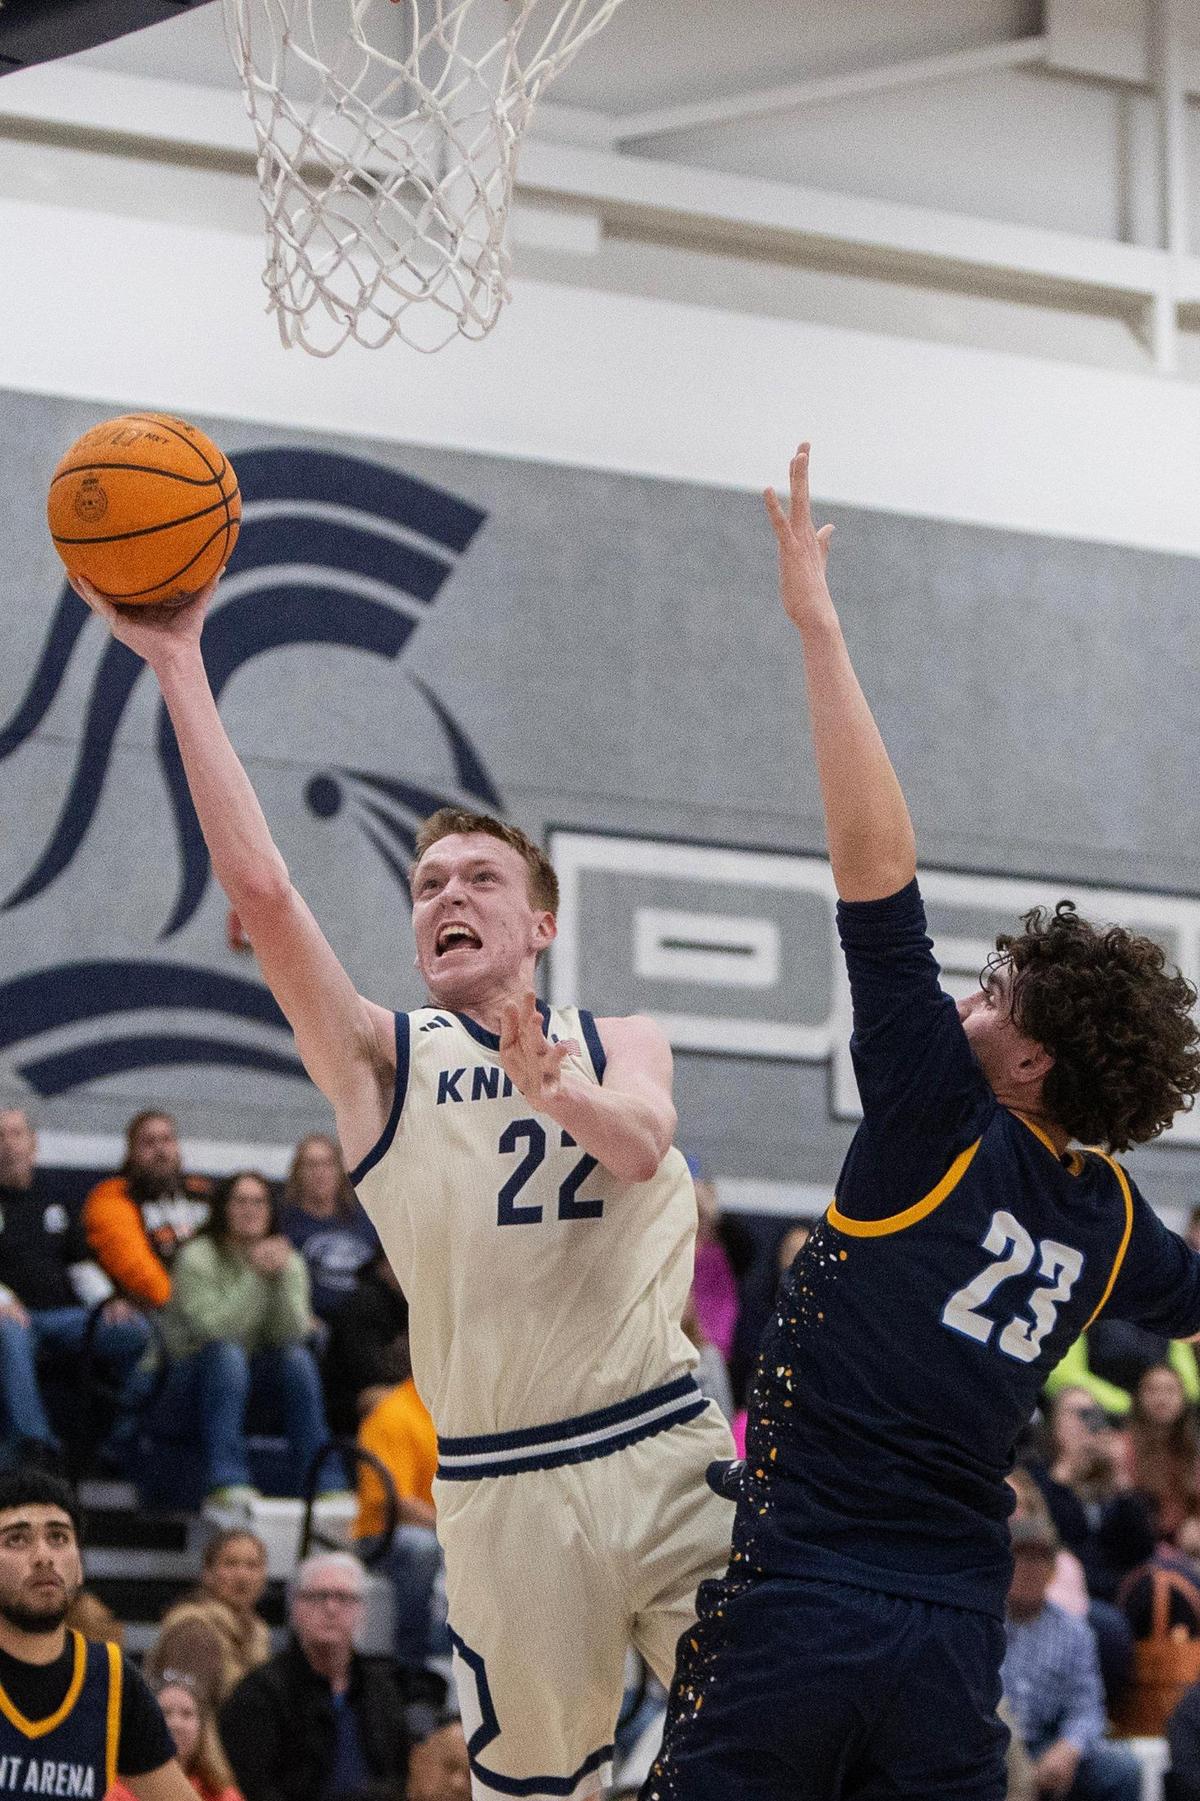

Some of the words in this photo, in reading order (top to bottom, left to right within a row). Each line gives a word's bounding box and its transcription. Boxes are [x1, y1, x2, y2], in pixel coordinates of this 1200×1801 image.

[437, 1066, 525, 1105] KNI
[497, 1118, 604, 1226] 22
[941, 1209, 1085, 1363] 23
[23, 1759, 95, 1797] ARENA
